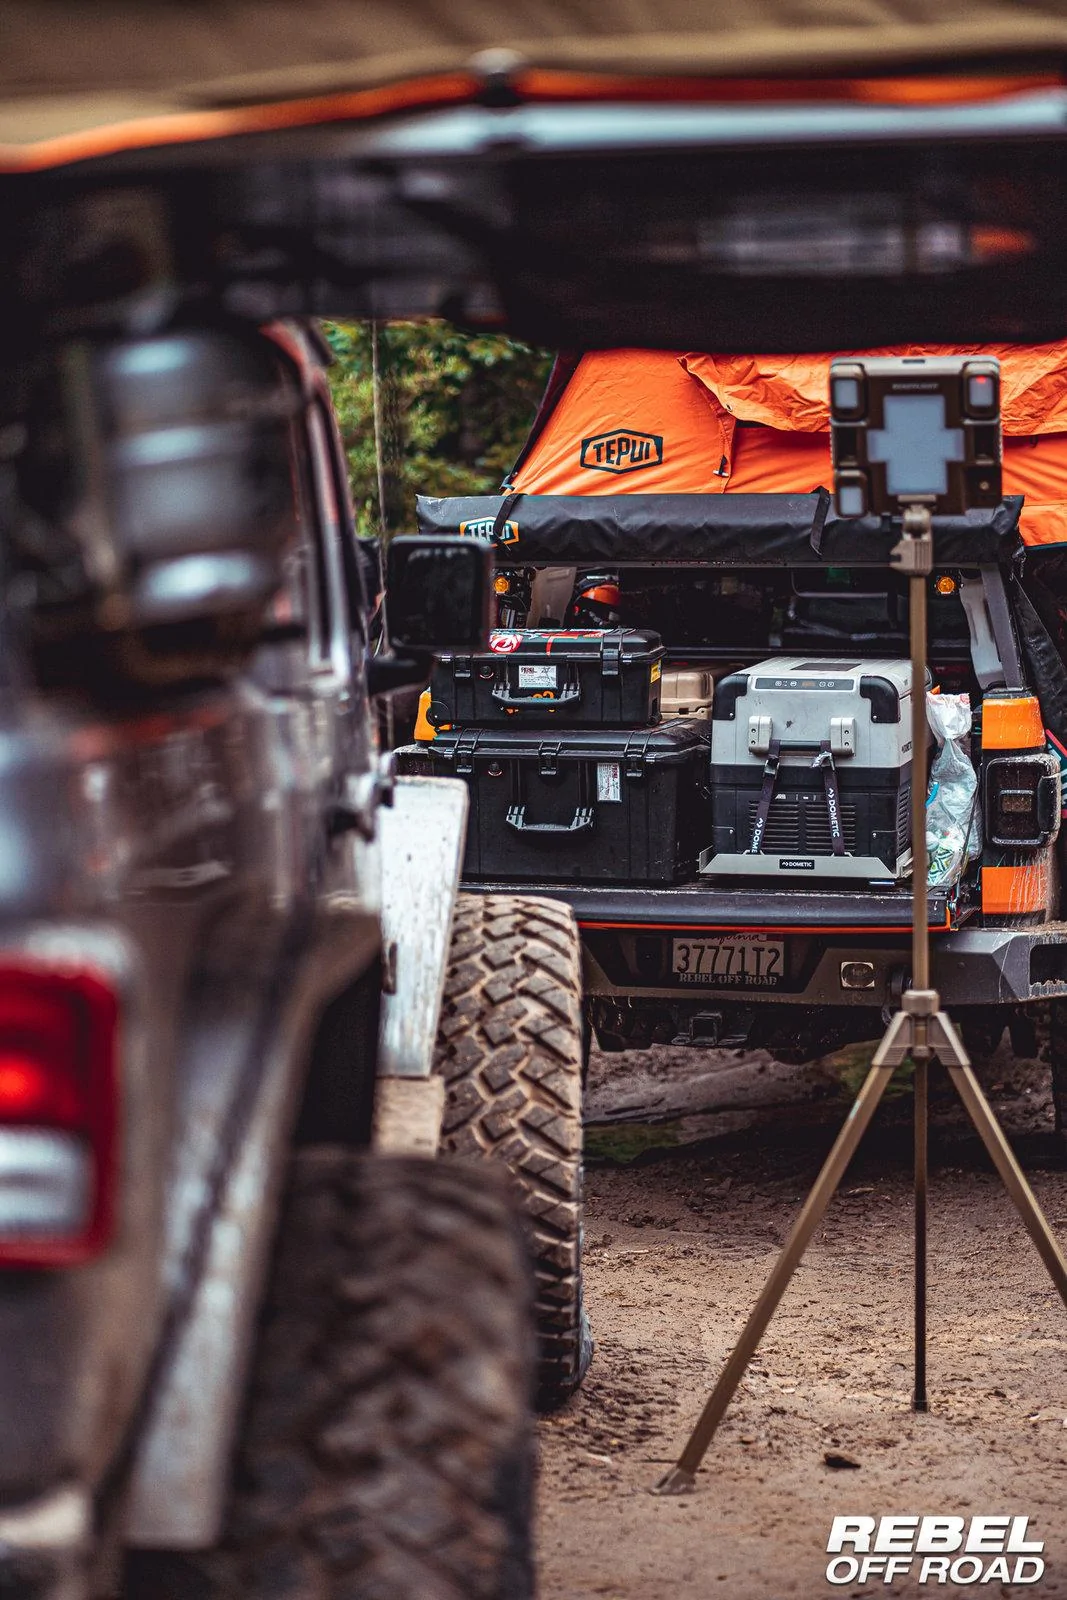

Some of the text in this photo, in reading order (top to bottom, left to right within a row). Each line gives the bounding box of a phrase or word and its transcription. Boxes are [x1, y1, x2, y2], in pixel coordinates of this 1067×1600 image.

[592, 437, 651, 466] TEPUI
[828, 799, 840, 838] DOMETIC
[677, 944, 781, 976] 37771T2
[679, 973, 777, 986] REBEL OFF ROAD
